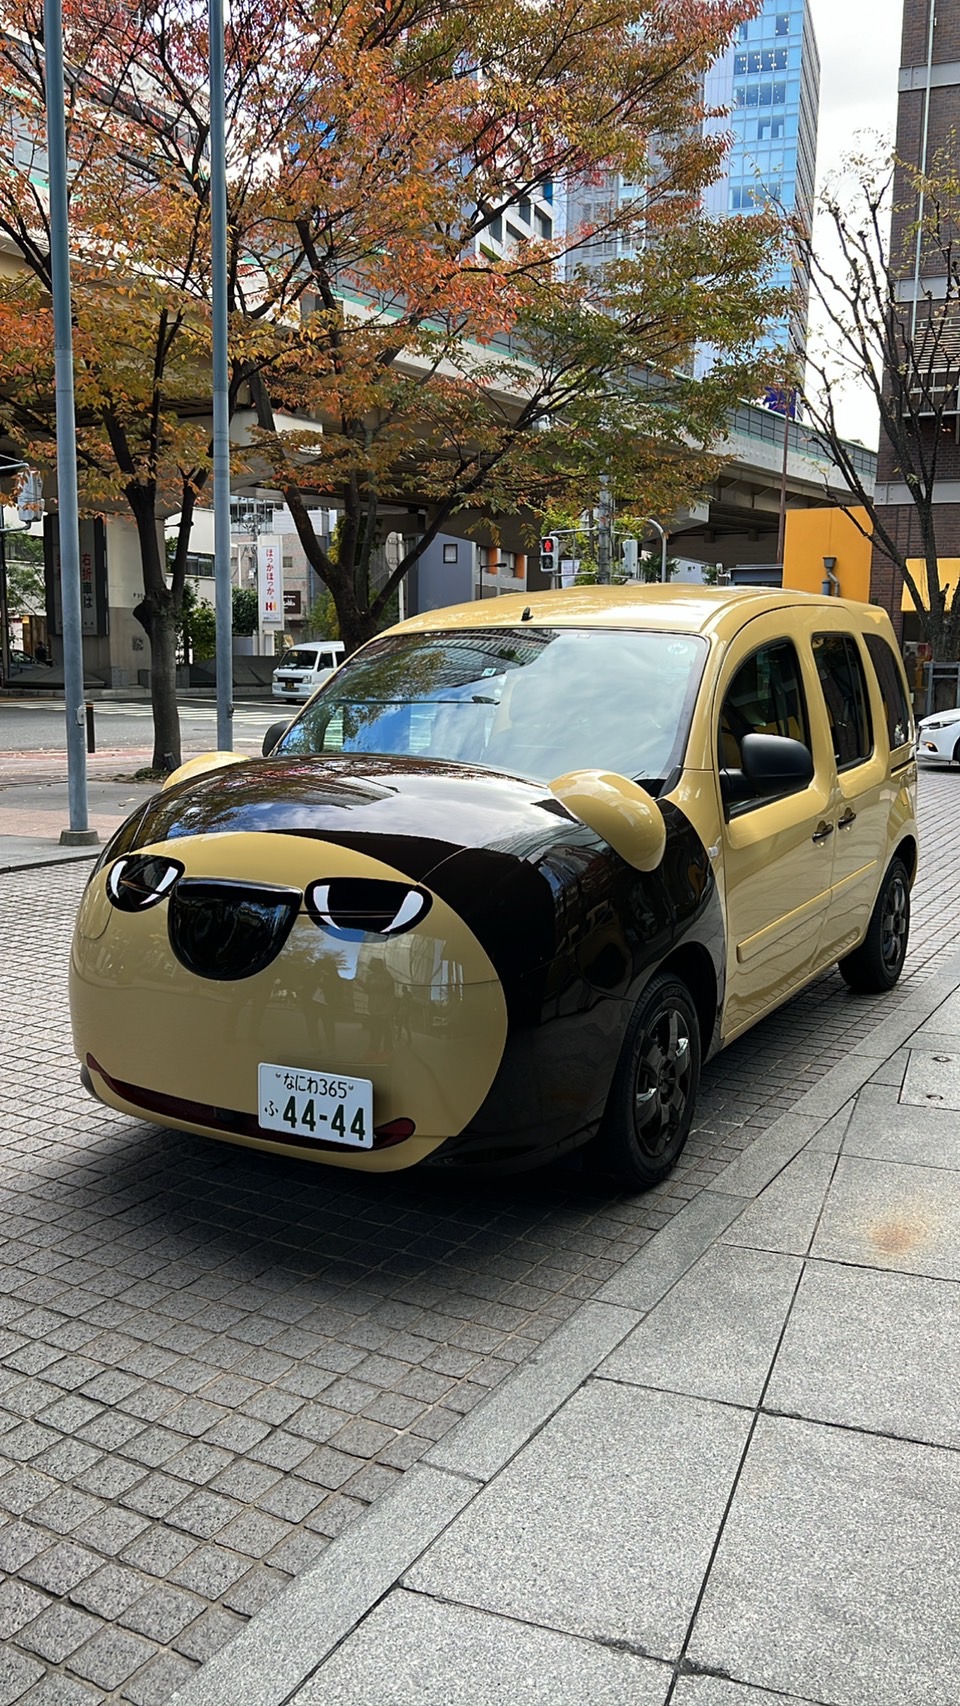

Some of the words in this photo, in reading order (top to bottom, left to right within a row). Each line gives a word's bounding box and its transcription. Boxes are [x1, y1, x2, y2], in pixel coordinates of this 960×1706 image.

[82, 553, 93, 609] 右折車は
[264, 1100, 279, 1117] ふ
[283, 1095, 365, 1141] 44-44
